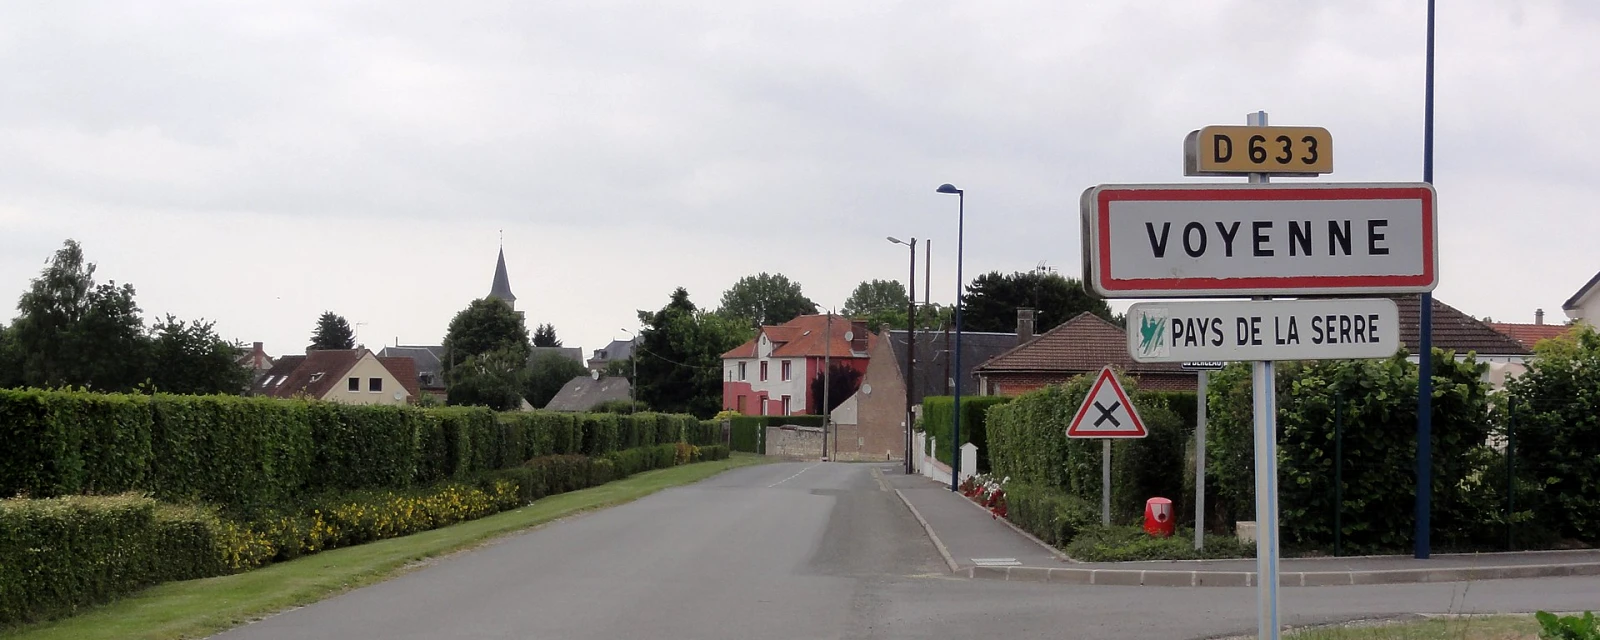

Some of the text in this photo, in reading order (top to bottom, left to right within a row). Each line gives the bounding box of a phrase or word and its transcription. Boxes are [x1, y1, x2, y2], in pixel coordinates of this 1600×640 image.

[1214, 134, 1319, 165] D 633
[1145, 219, 1391, 259] VOYENNE
[1171, 314, 1381, 348] PAYS DE LA SERRE
